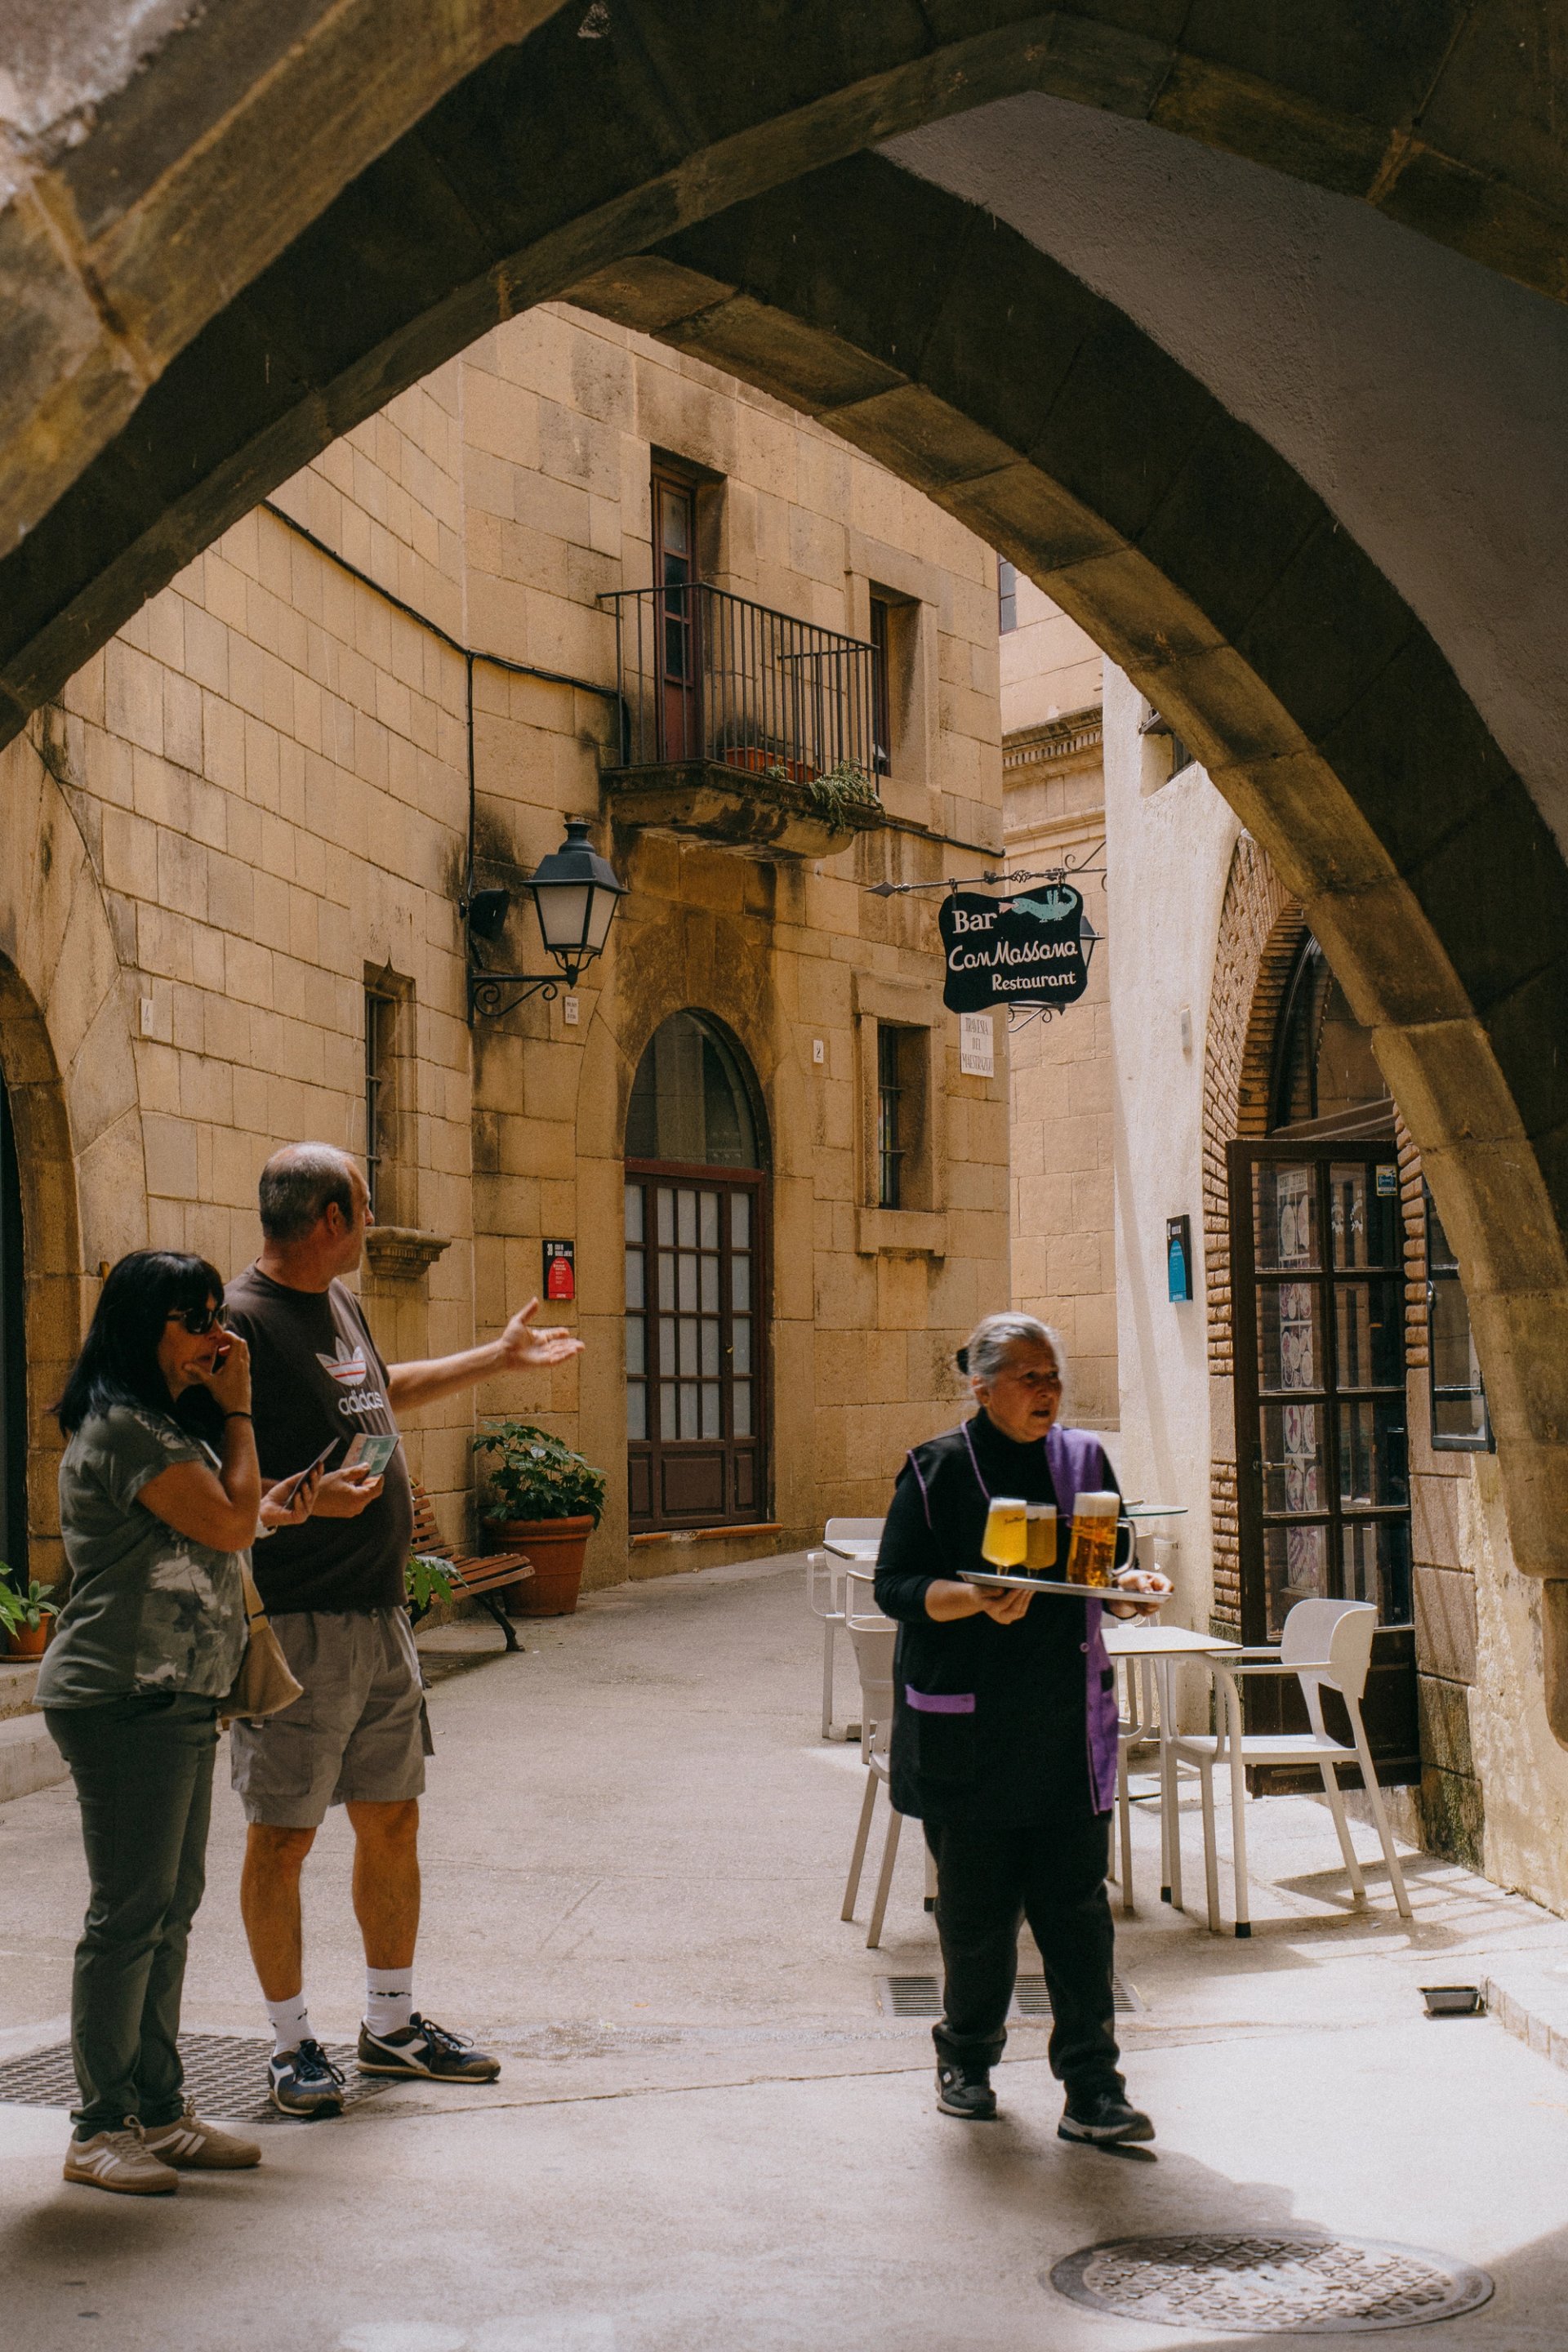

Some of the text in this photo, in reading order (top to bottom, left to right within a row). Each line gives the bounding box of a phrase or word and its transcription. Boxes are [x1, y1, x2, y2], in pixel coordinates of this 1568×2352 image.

[952, 910, 997, 933] Bar
[948, 940, 1078, 972] Can Massana
[992, 971, 1076, 991] Restaurant
[816, 1045, 822, 1058] 2
[972, 1037, 981, 1050] DEL
[338, 1388, 384, 1415] adidas
